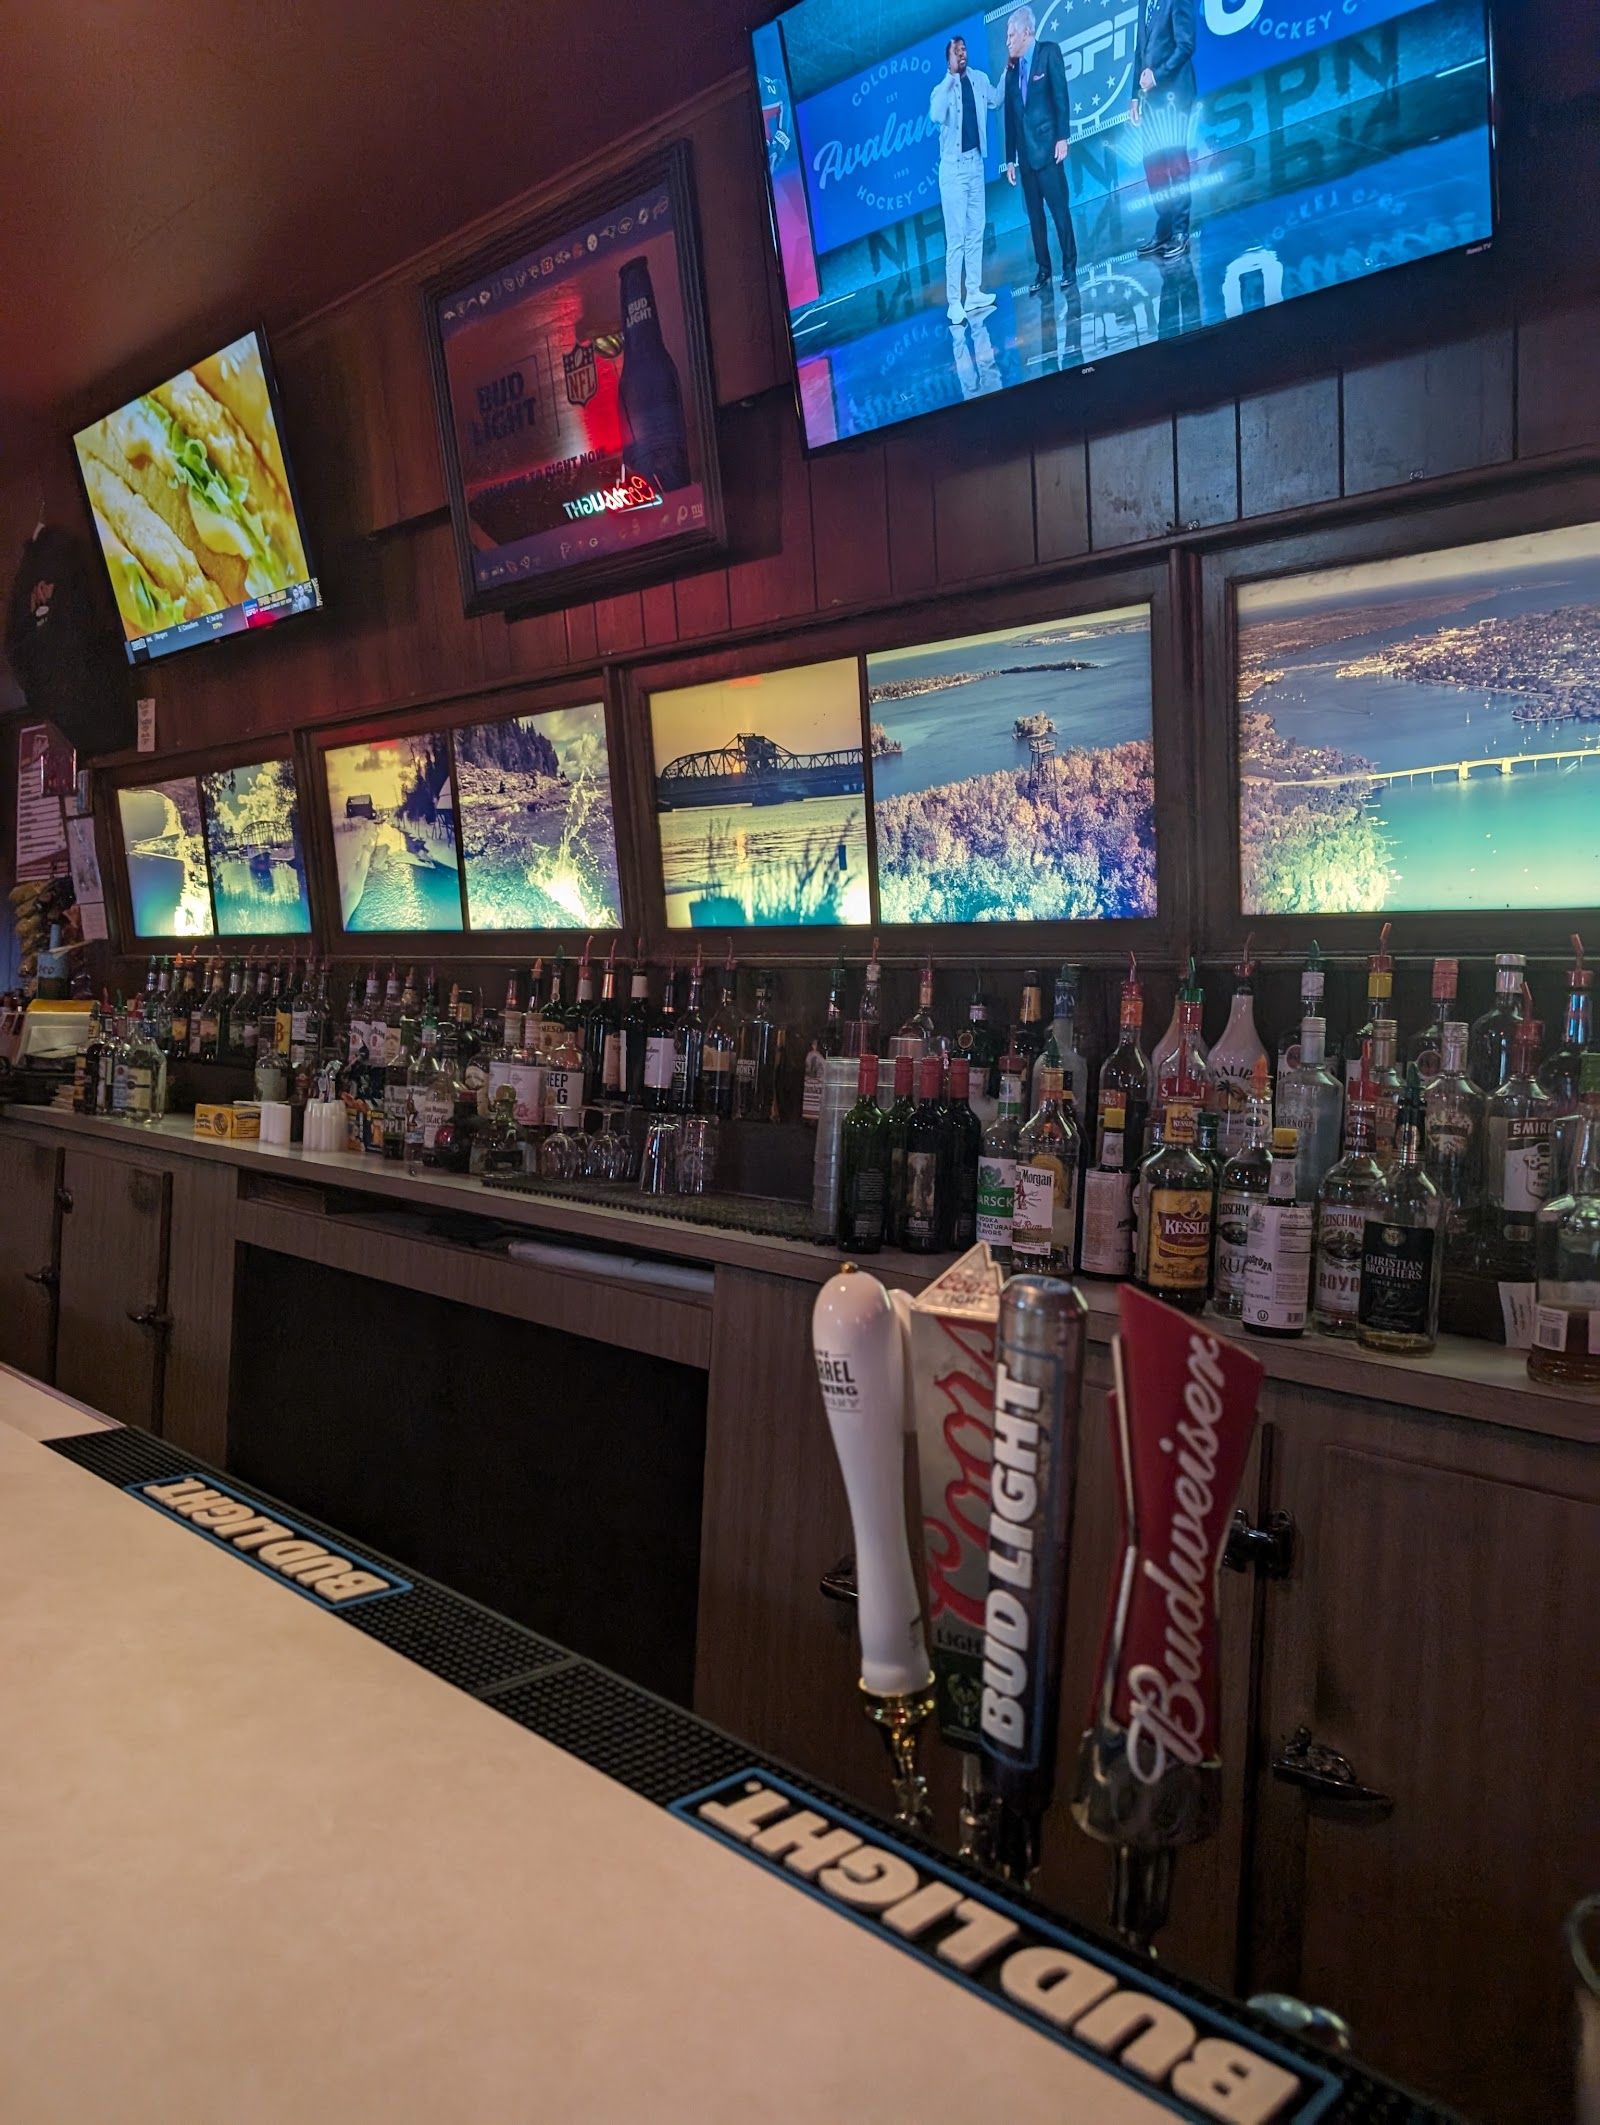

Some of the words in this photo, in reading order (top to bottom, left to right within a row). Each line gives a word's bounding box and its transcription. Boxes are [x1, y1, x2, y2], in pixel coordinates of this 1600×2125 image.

[851, 56, 932, 107] COLORADO
[857, 184, 913, 211] HOCKEY
[626, 307, 652, 328] LIGHT
[628, 298, 647, 315] BUD
[476, 371, 525, 413] BUD
[567, 367, 596, 400] NFL
[470, 398, 536, 446] LIGHT
[1020, 1168, 1052, 1187] Morgan
[1165, 1219, 1210, 1235] KESSLE
[1219, 1255, 1247, 1274] RU
[1365, 1254, 1424, 1271] CHRISTIAN
[1365, 1263, 1423, 1281] BROTHERS
[1319, 1272, 1361, 1292] ROYA
[988, 1361, 1042, 1590] LIGHT
[143, 1476, 295, 1550] LIGHT
[257, 1538, 391, 1604] BUD
[1127, 1333, 1227, 1784] Budweiser
[936, 1629, 982, 1657] LIGH
[980, 1588, 1031, 1750] BUD
[697, 1779, 1020, 1973] LIGHT
[1001, 1945, 1303, 2125] BUD
